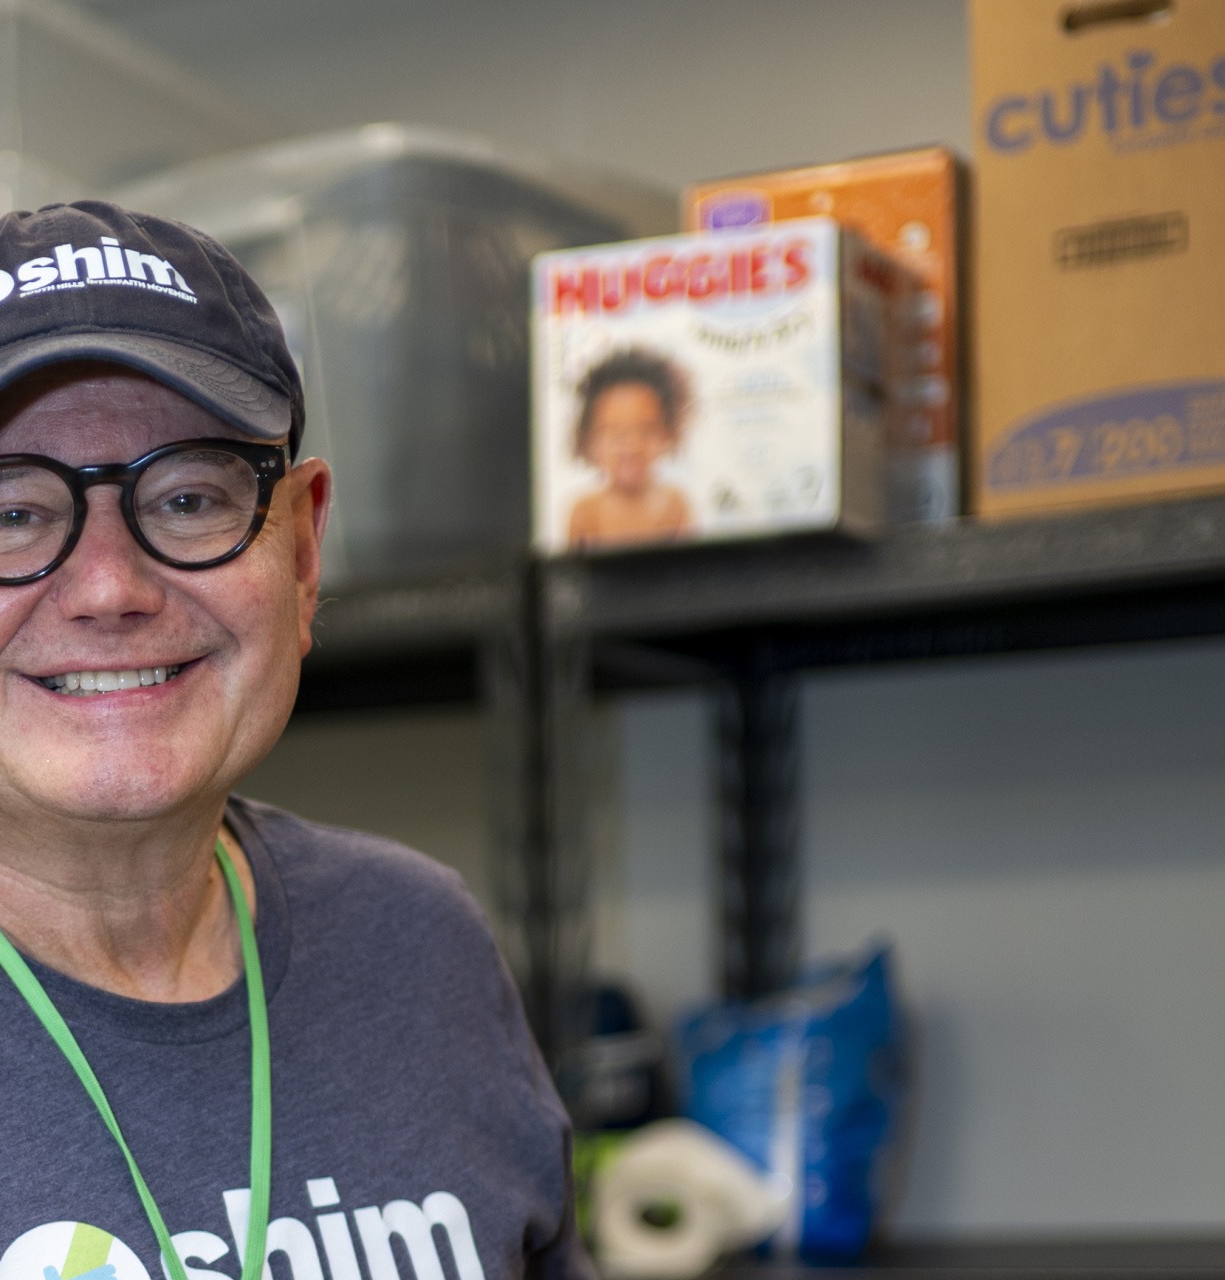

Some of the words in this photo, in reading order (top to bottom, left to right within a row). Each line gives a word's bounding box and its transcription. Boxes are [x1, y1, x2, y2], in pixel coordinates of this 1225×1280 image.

[17, 236, 195, 296] shim
[56, 280, 86, 291] HILLS
[86, 277, 147, 290] INTERFAITH
[147, 282, 198, 304] MOVEMENT
[552, 238, 812, 315] HUGGIES
